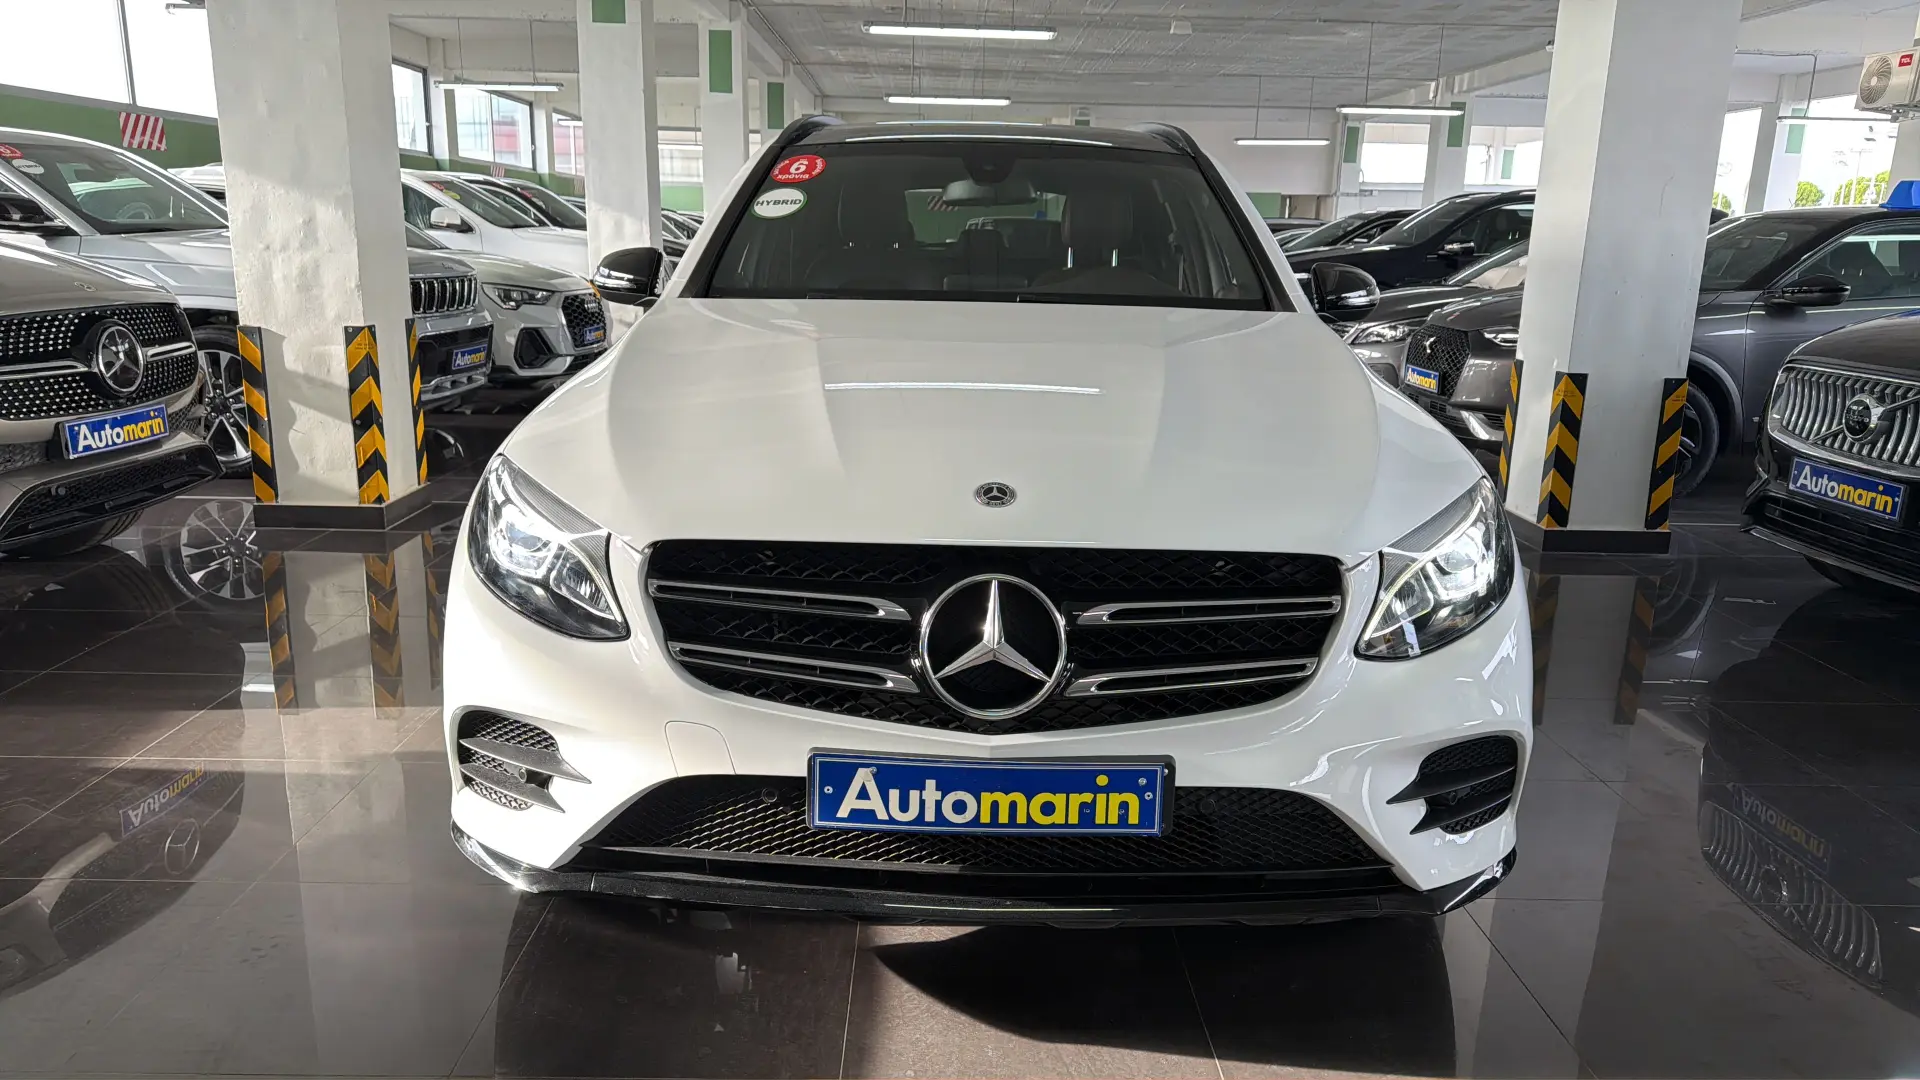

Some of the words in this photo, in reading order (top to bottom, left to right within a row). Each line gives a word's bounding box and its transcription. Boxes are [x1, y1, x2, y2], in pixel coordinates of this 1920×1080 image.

[790, 160, 808, 174] 6
[755, 198, 803, 207] HYBRID
[454, 347, 486, 366] Automarin
[77, 410, 165, 452] Automarin
[1796, 464, 1894, 514] Automarin
[835, 766, 1141, 825] Automarin
